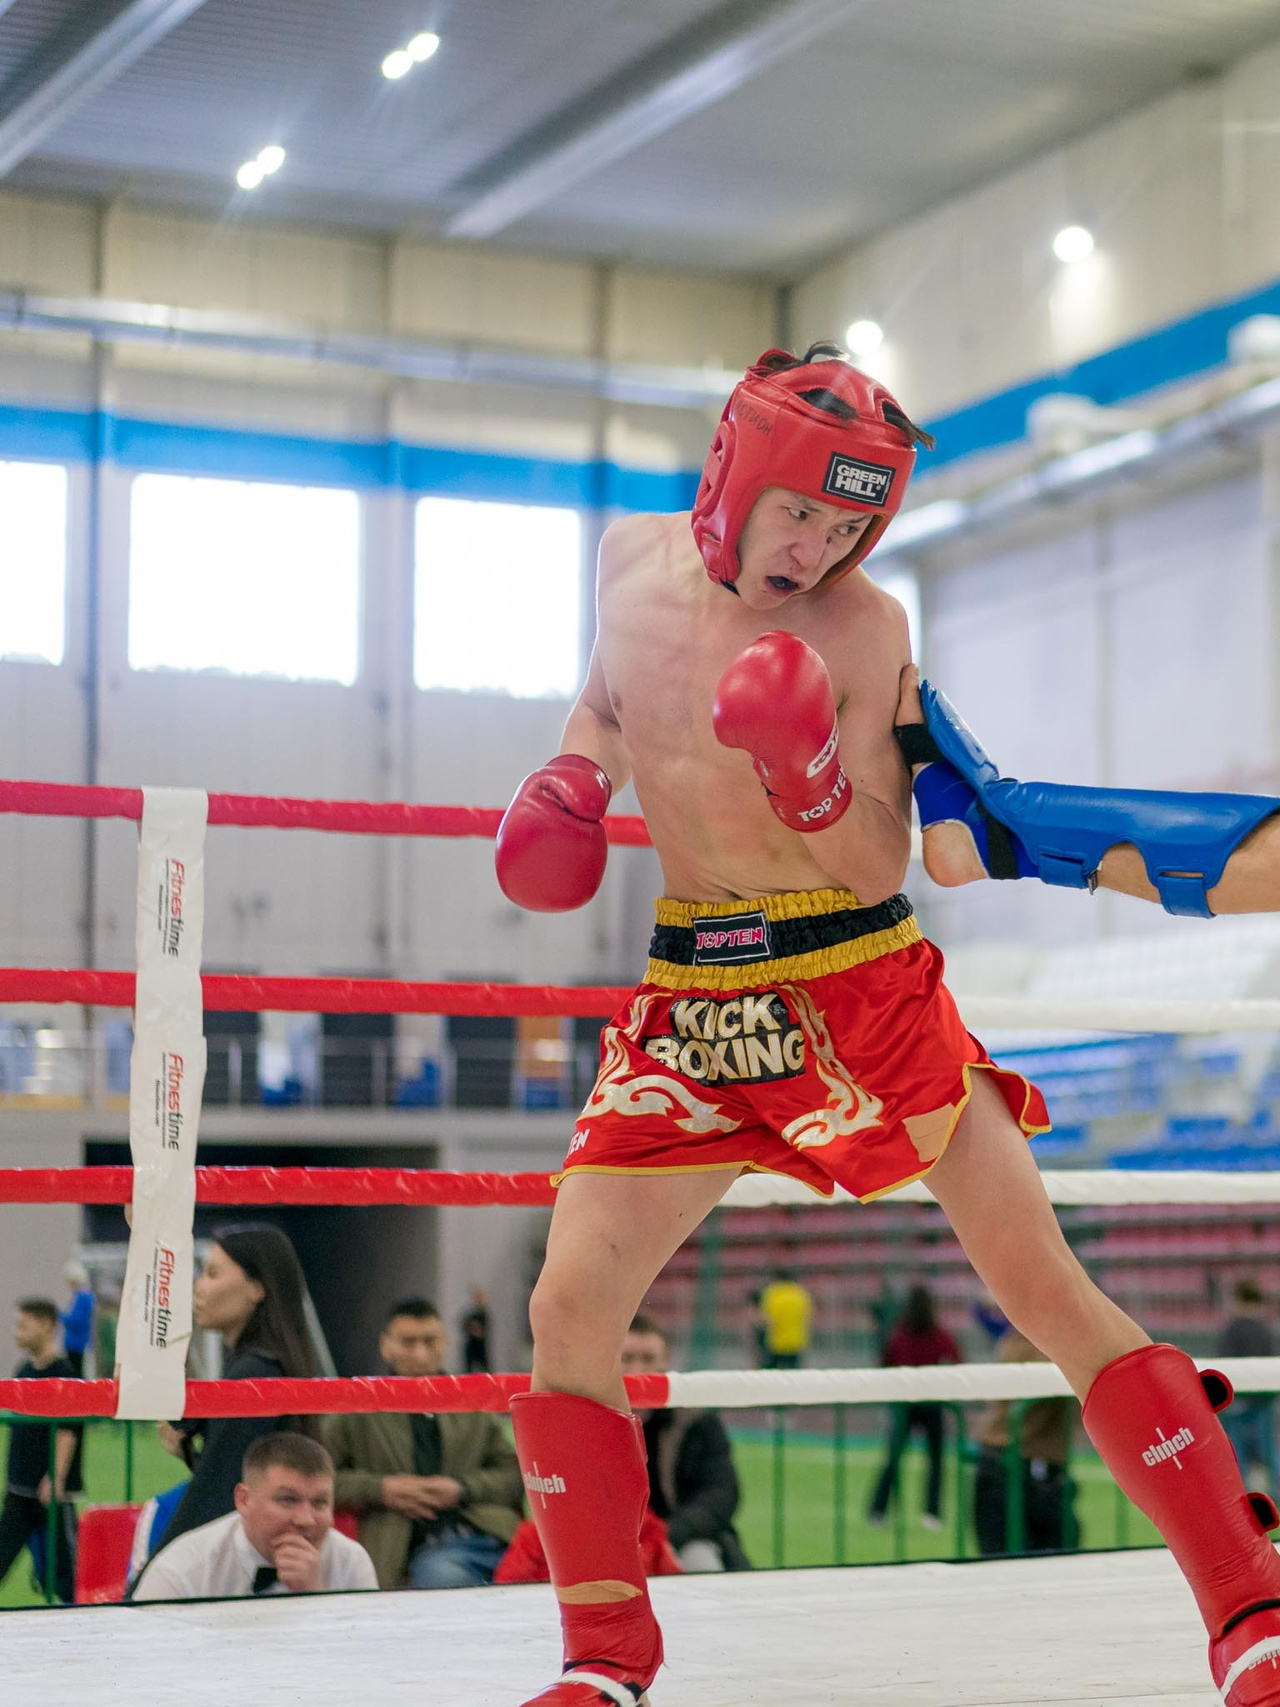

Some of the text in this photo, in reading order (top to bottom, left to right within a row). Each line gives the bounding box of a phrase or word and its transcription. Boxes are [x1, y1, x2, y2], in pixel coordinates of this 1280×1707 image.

[835, 474, 876, 497] HILL
[837, 464, 887, 486] GREEN
[797, 798, 832, 822] TOP
[168, 858, 185, 958] Fitnestime
[674, 993, 782, 1040] KICK
[645, 1029, 805, 1081] BOXING
[168, 1052, 184, 1152] Fitnestime
[156, 1247, 175, 1349] Fitnestime
[1141, 1427, 1195, 1467] clinch
